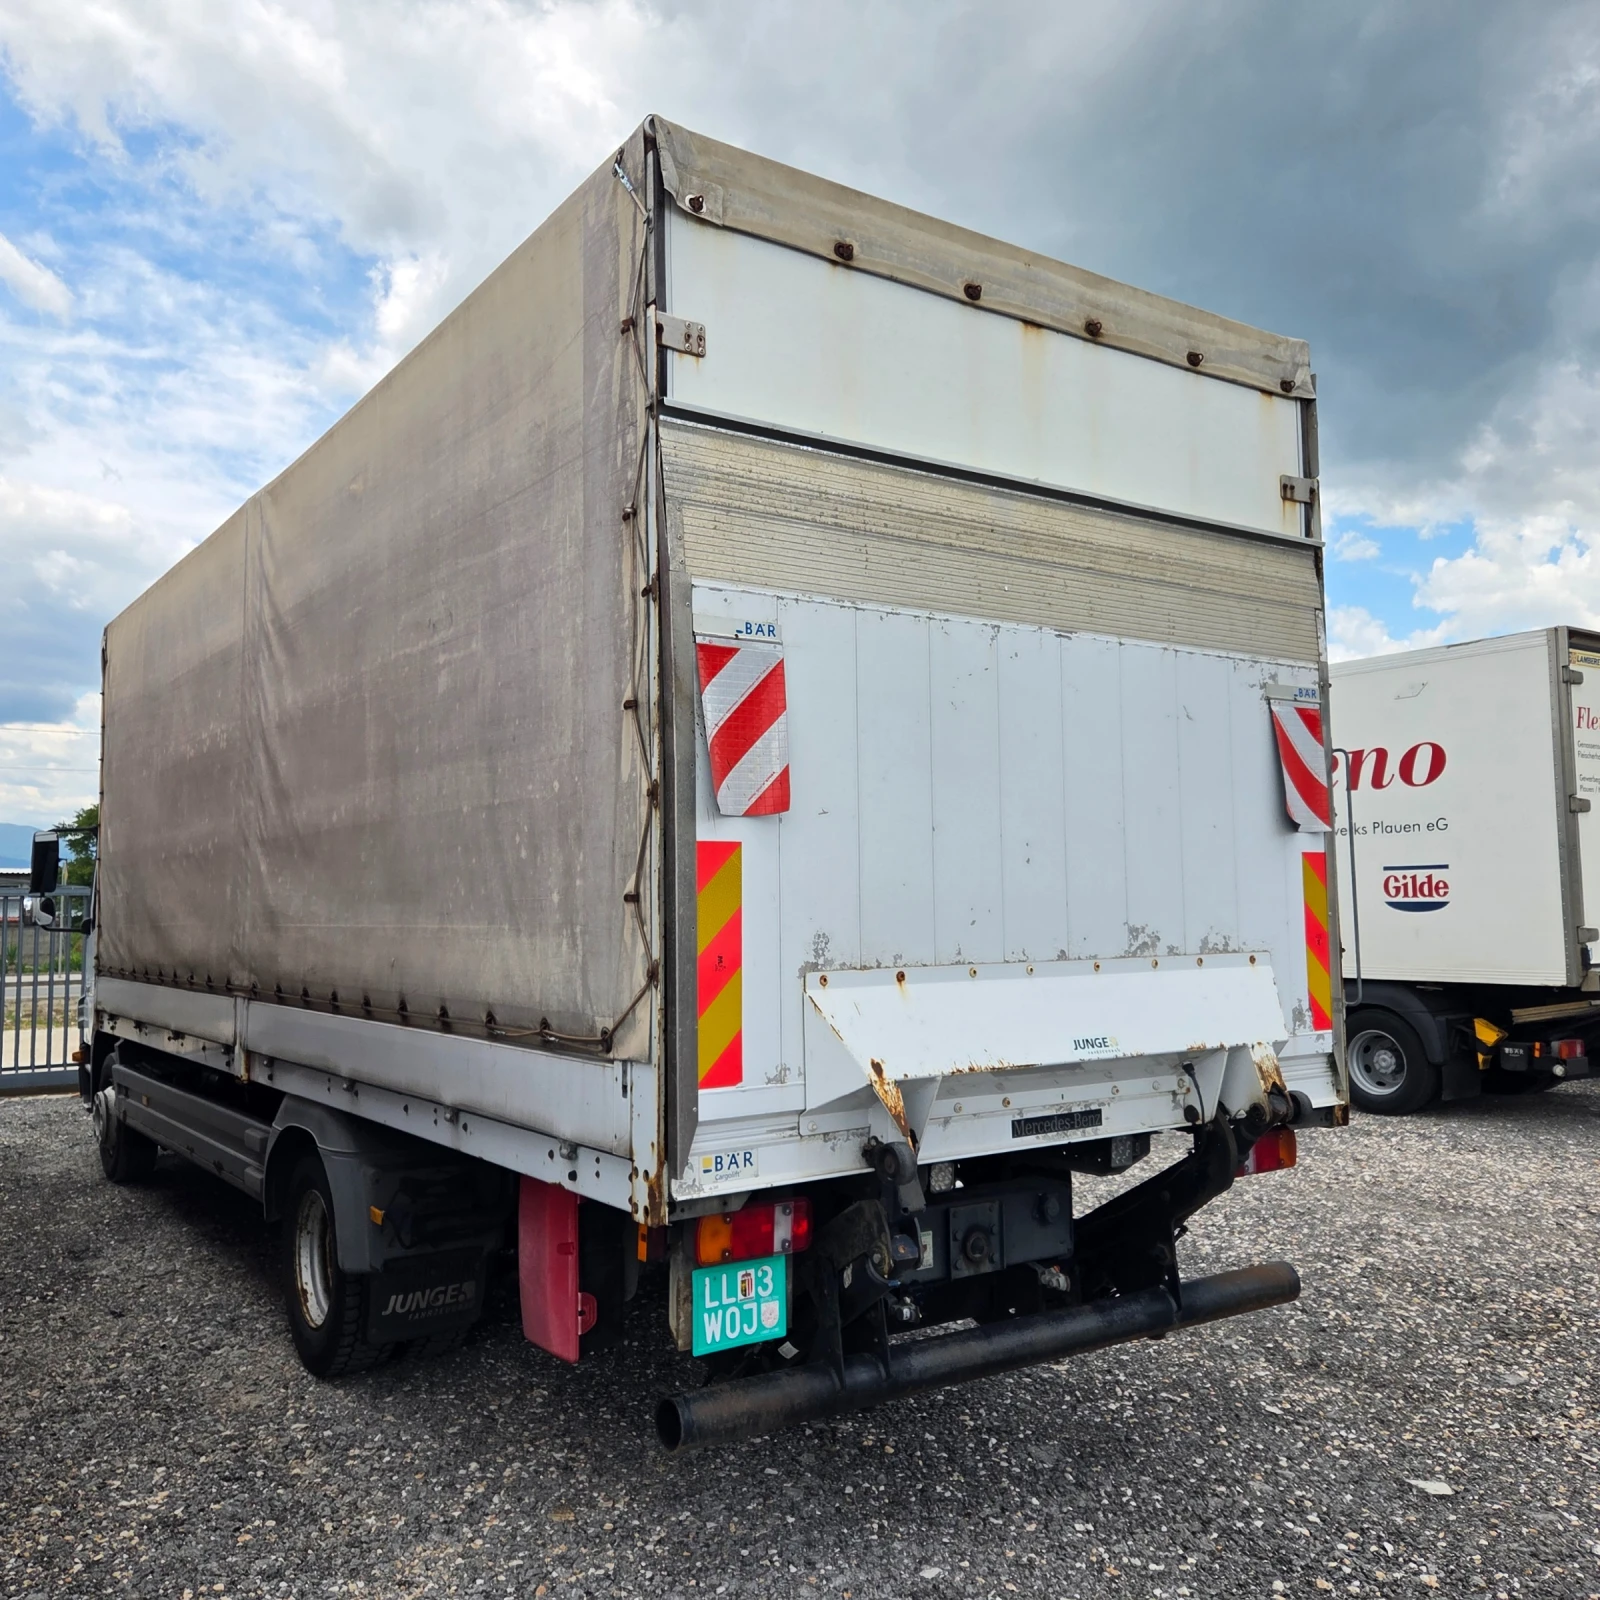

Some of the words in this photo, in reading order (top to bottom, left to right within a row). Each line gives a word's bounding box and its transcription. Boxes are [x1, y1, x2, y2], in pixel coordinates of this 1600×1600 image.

[745, 621, 776, 637] BÄR
[1298, 687, 1316, 699] BÄR
[1576, 706, 1600, 731] Fle
[1331, 741, 1448, 791] no
[1373, 820, 1421, 835] Plauen
[1426, 817, 1449, 832] eG
[1383, 873, 1450, 899] Gilde
[1073, 1036, 1109, 1051] JUNGE
[1013, 1110, 1102, 1137] Mercedes-Benz
[714, 1150, 754, 1173] BÄR
[381, 1282, 461, 1316] JUNGE
[704, 1273, 737, 1309] LL
[757, 1265, 774, 1297] 3
